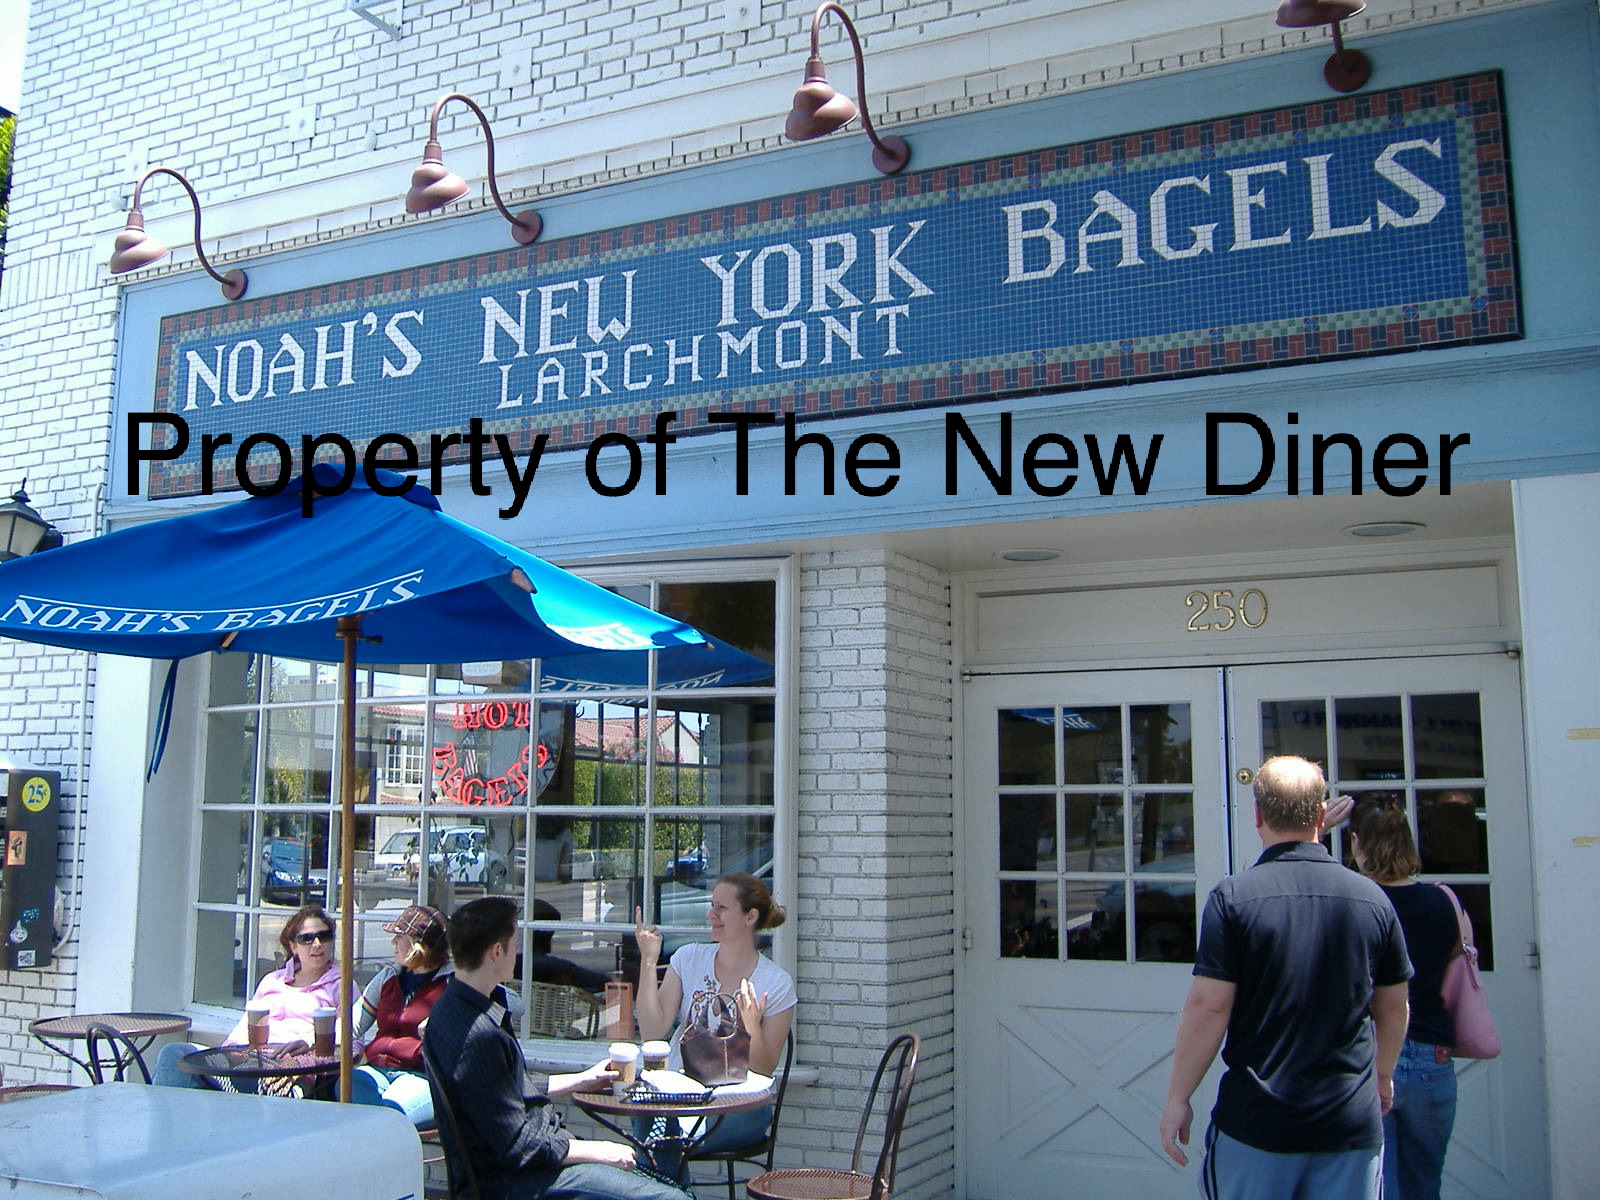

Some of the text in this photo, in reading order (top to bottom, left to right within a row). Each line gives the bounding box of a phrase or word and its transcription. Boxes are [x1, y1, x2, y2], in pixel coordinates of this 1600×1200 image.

[182, 136, 1449, 412] NOAH'S NEW YORK BAGELS
[495, 303, 911, 411] LARCHMONT
[0, 574, 424, 635] NOAH'S BAGELS
[1184, 588, 1268, 632] 250
